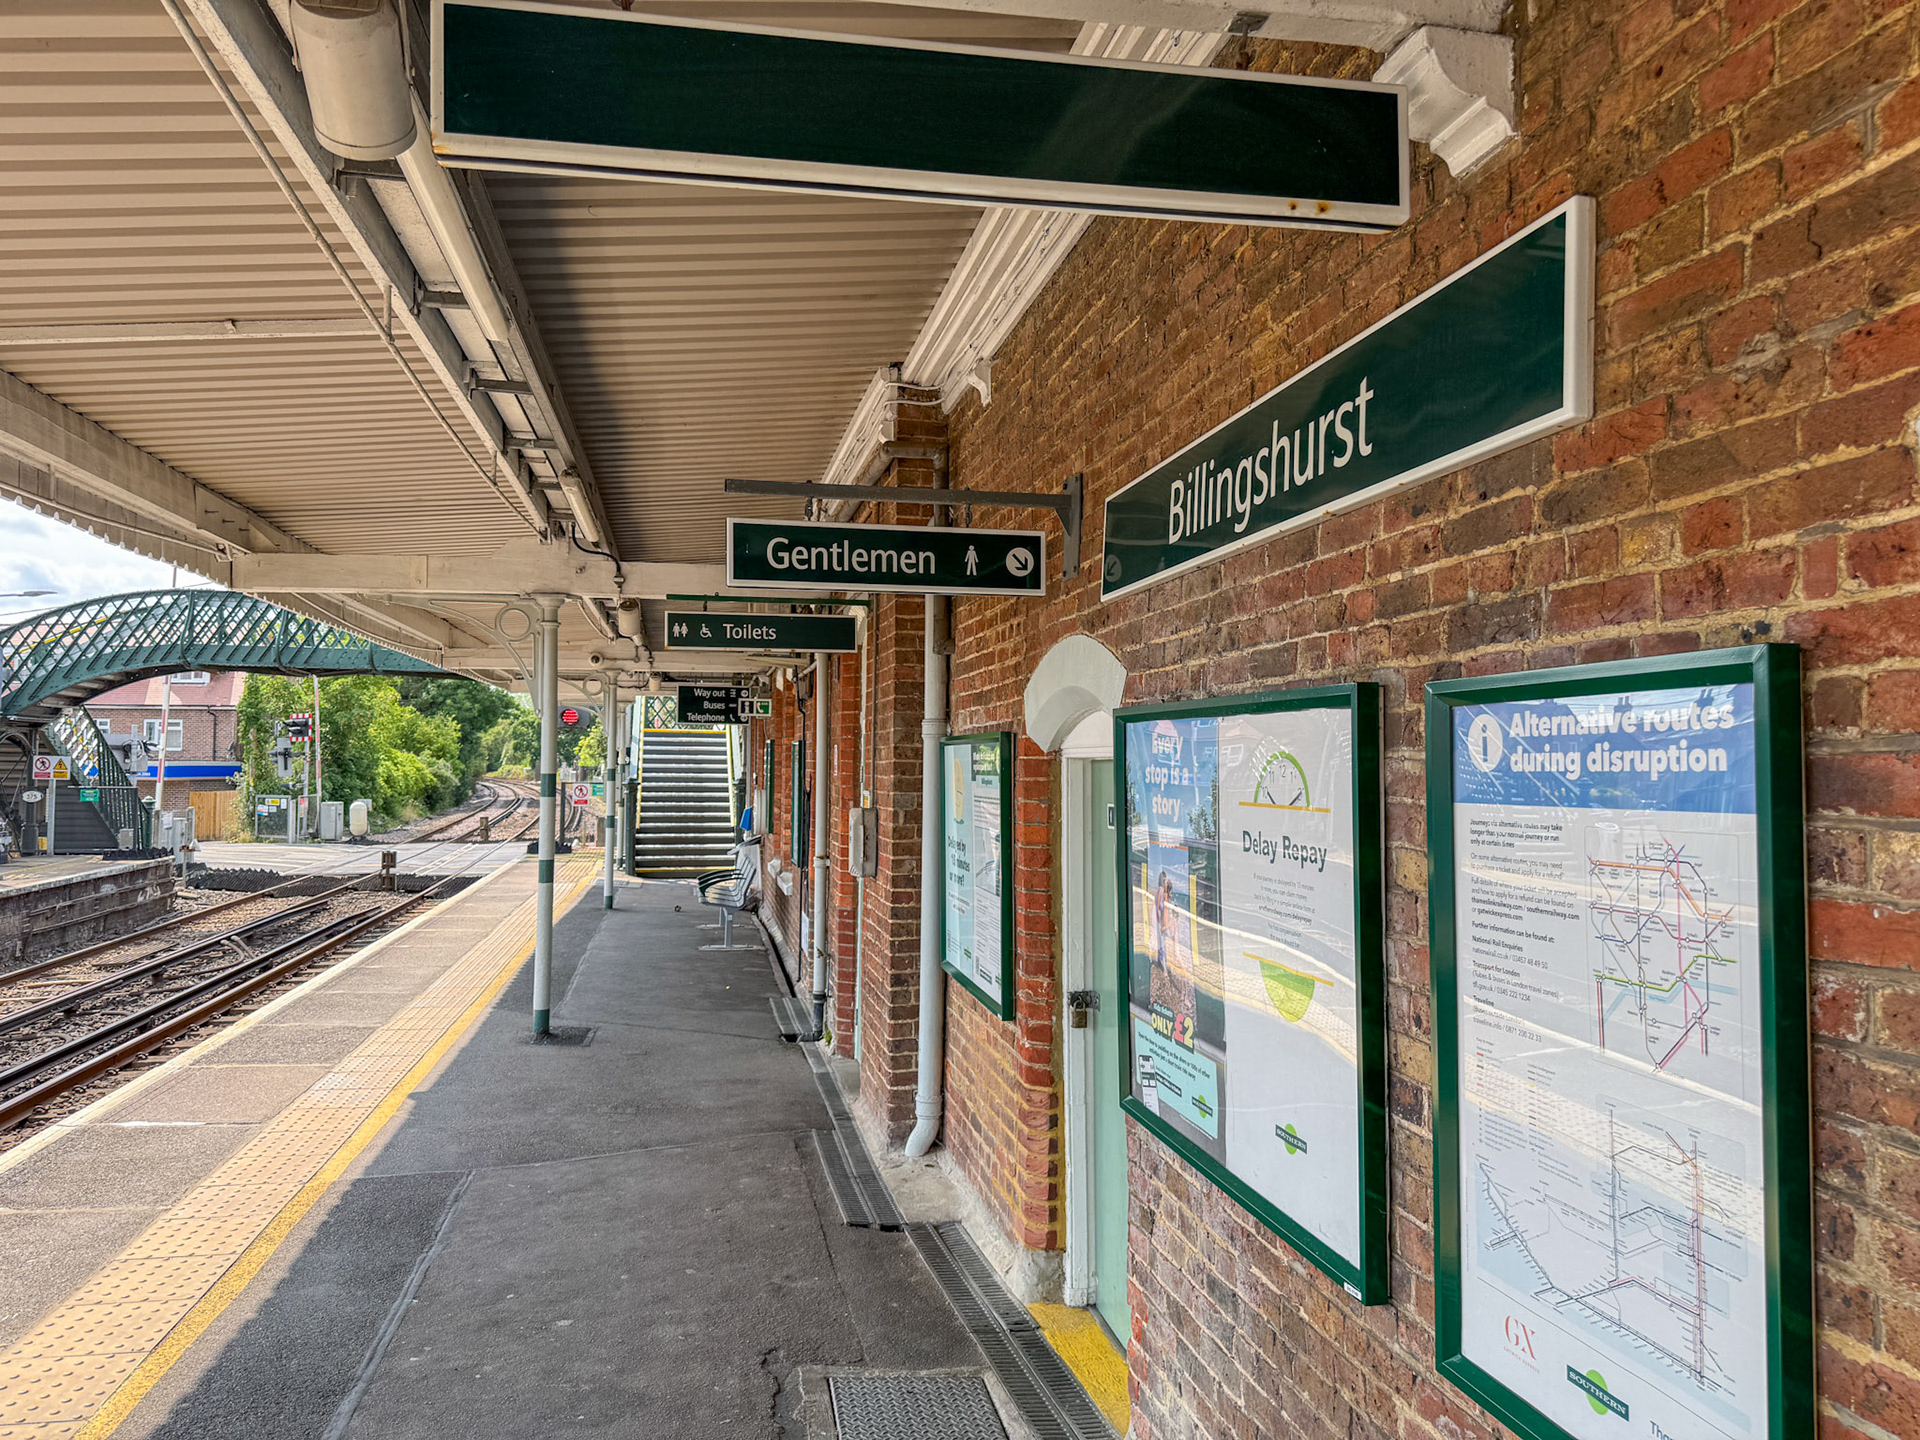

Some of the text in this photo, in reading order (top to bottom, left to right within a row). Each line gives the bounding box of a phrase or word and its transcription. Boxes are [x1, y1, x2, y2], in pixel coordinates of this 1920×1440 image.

[1168, 376, 1375, 546] Billingshurst
[766, 536, 936, 575] Gentlemen
[722, 623, 777, 640] Toilets
[693, 688, 726, 699] Way out
[703, 701, 726, 710] Buses
[686, 712, 726, 723] Telephone
[1509, 701, 1735, 738] Alternative routes
[1151, 732, 1183, 761] Every
[1509, 739, 1728, 781] during disruption
[1145, 760, 1189, 791] stop is a
[1152, 793, 1181, 823] story
[1242, 830, 1327, 873] Delay Repay
[1151, 1012, 1174, 1037] ONLY
[1174, 1012, 1194, 1049] £2
[1276, 1128, 1306, 1150] SOUTHERN
[1505, 1315, 1537, 1361] GX
[1568, 1371, 1627, 1415] SOUTHERN
